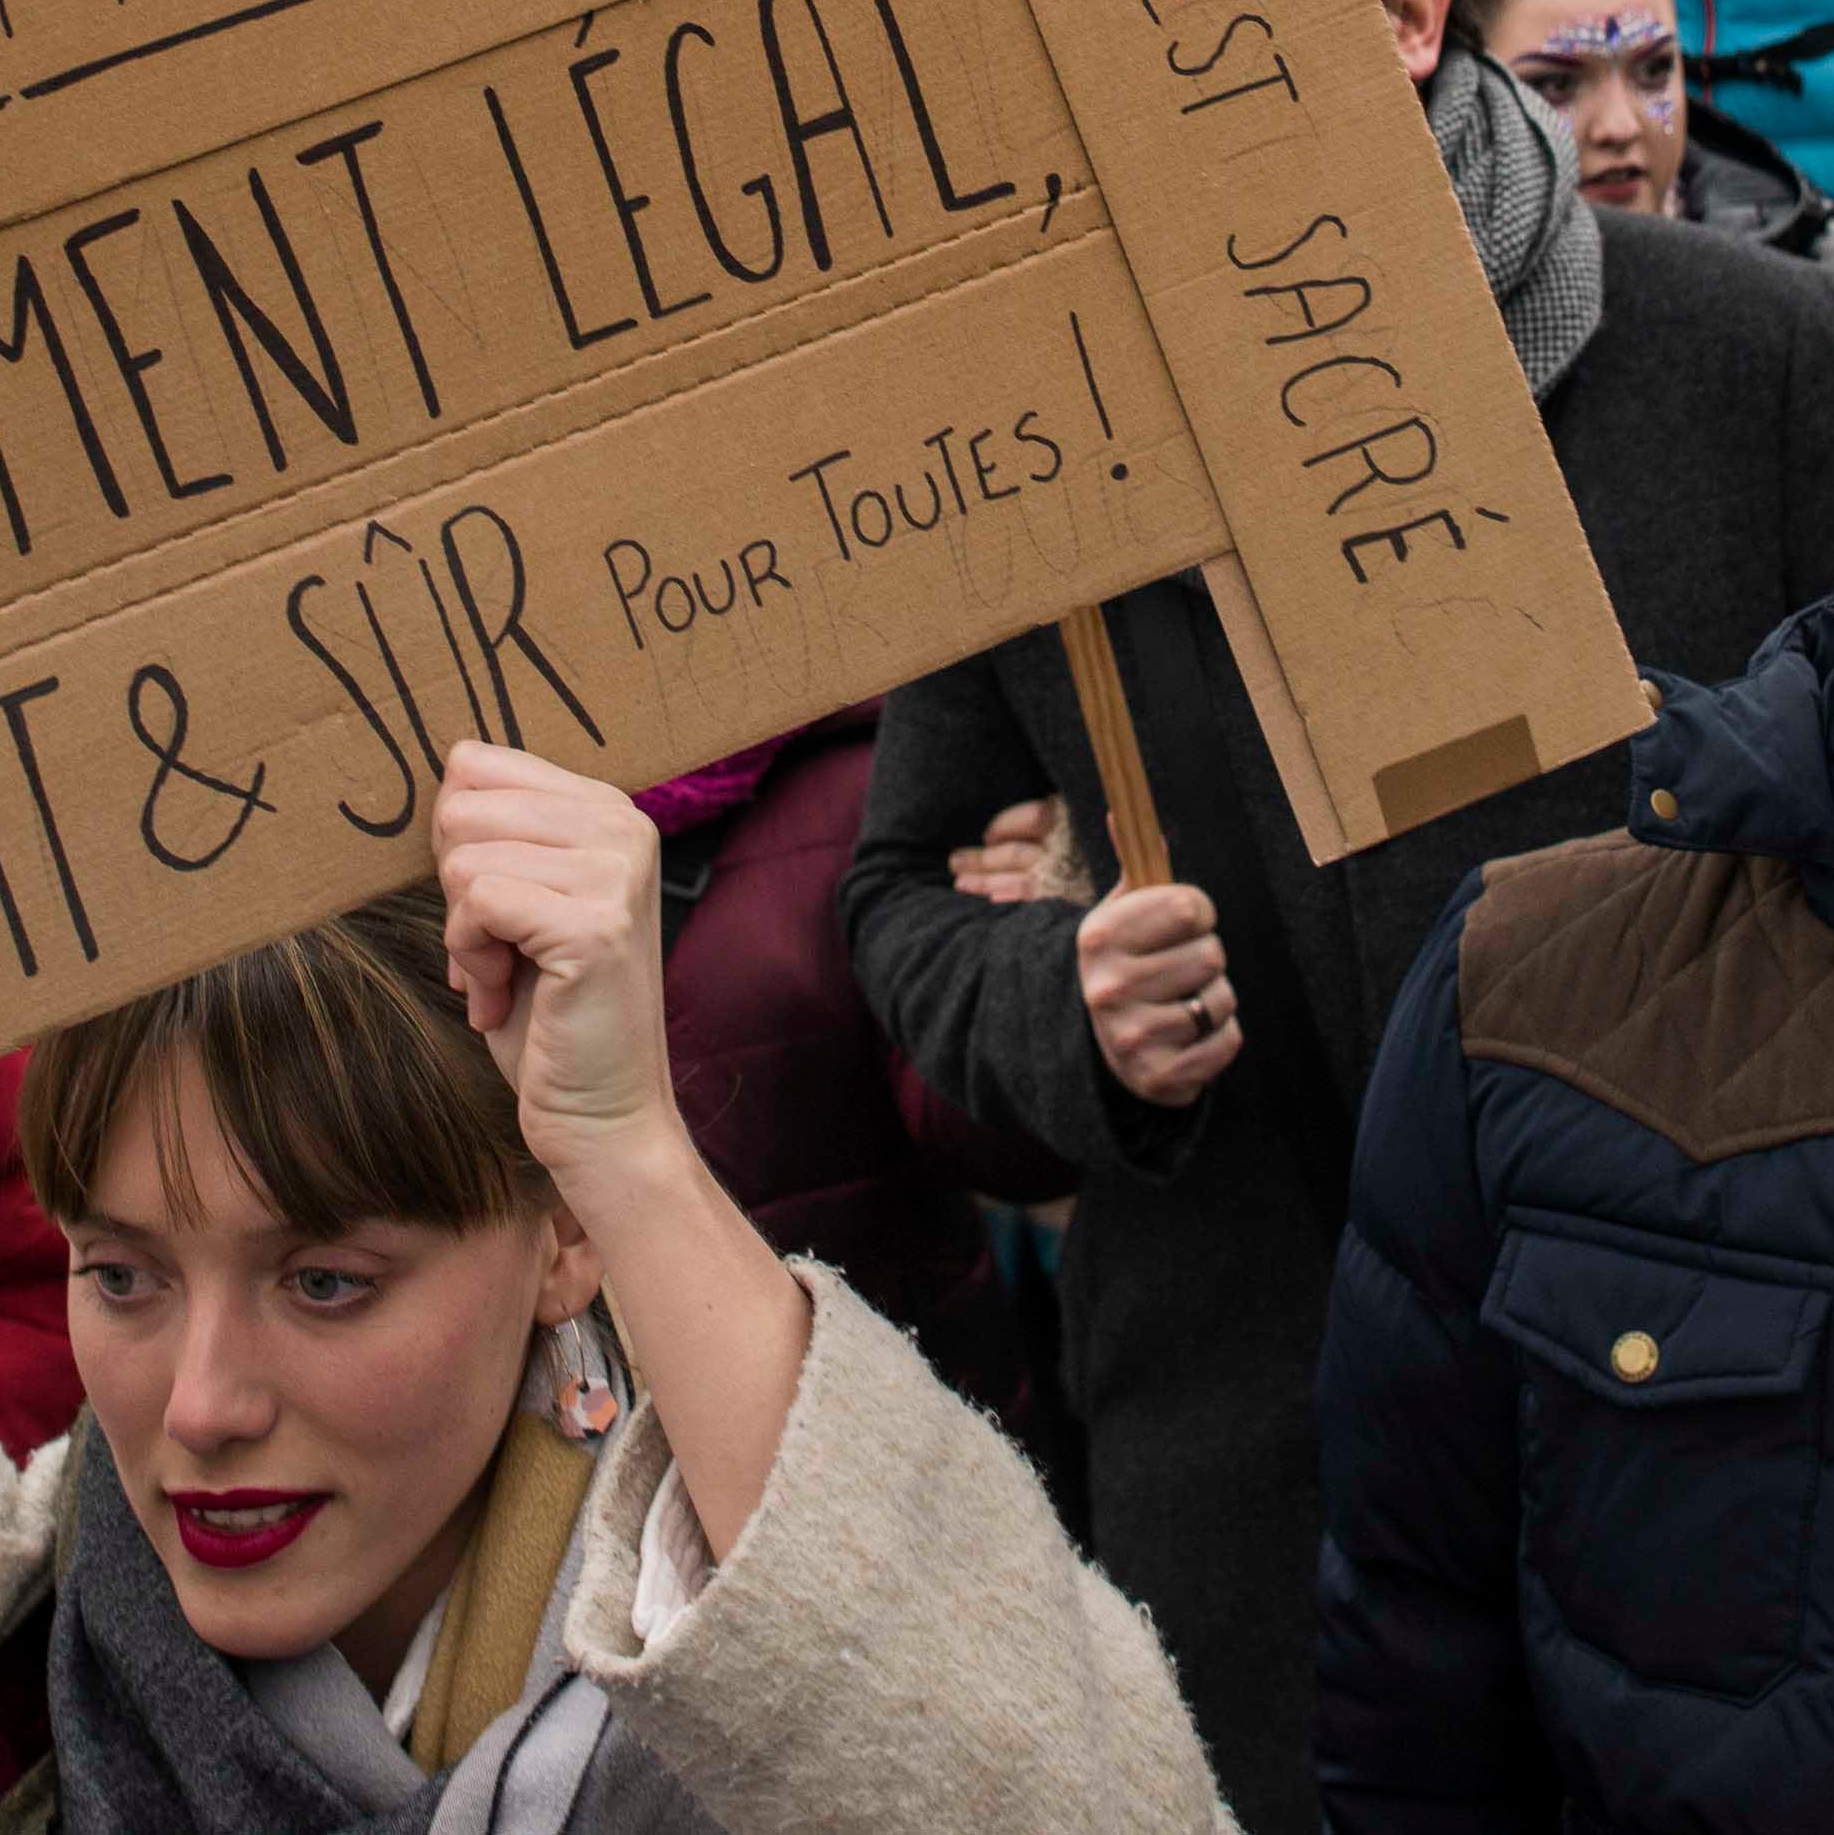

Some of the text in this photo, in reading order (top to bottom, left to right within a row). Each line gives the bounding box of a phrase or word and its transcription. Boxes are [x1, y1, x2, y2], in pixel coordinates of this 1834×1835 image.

[1227, 213, 1511, 585] SACRÉ
[127, 661, 278, 872] &
[286, 503, 607, 839] SÛR
[604, 537, 792, 651] POUR
